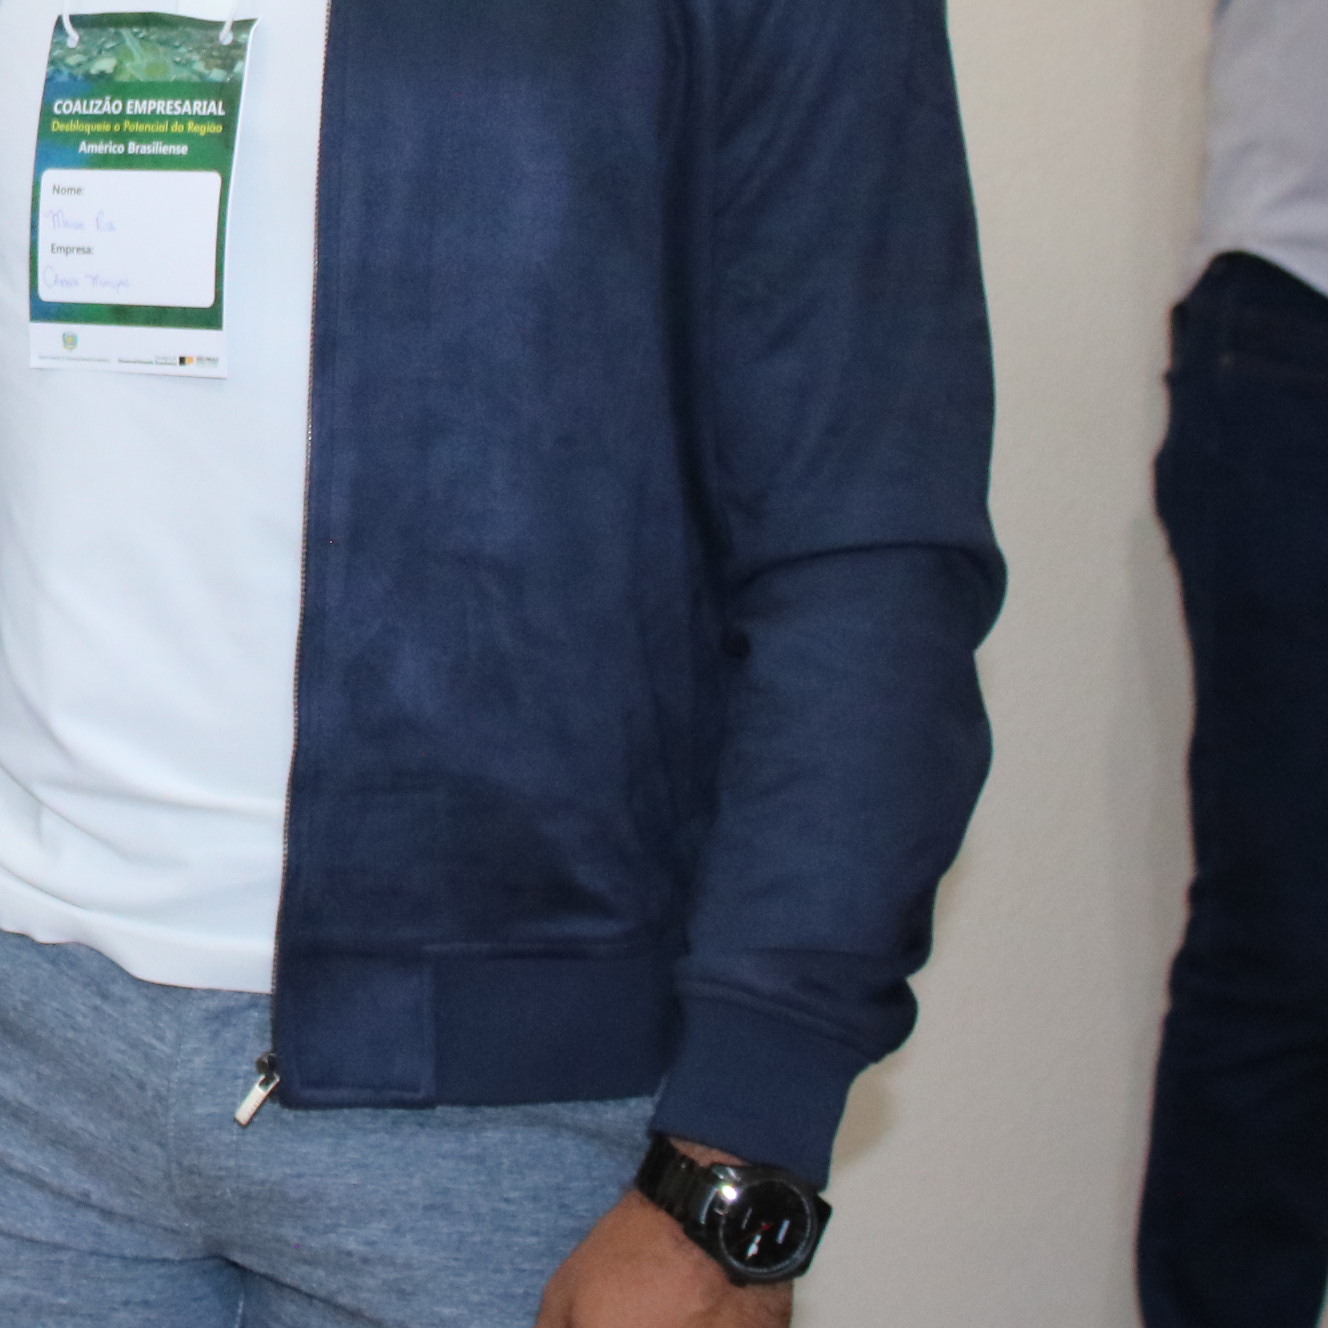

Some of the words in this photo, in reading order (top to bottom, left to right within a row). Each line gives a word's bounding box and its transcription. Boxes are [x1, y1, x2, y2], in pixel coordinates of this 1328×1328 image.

[53, 96, 123, 115] COALIZÃO
[126, 99, 225, 116] EMPRESARIAL
[51, 120, 111, 135] Desbloqueie
[114, 124, 120, 132] o
[123, 120, 168, 132] Potencial
[188, 120, 223, 136] Região
[78, 140, 125, 154] Américo
[128, 140, 188, 155] Brasiliense
[52, 184, 84, 195] Nome:
[51, 243, 94, 256] Empresa:
